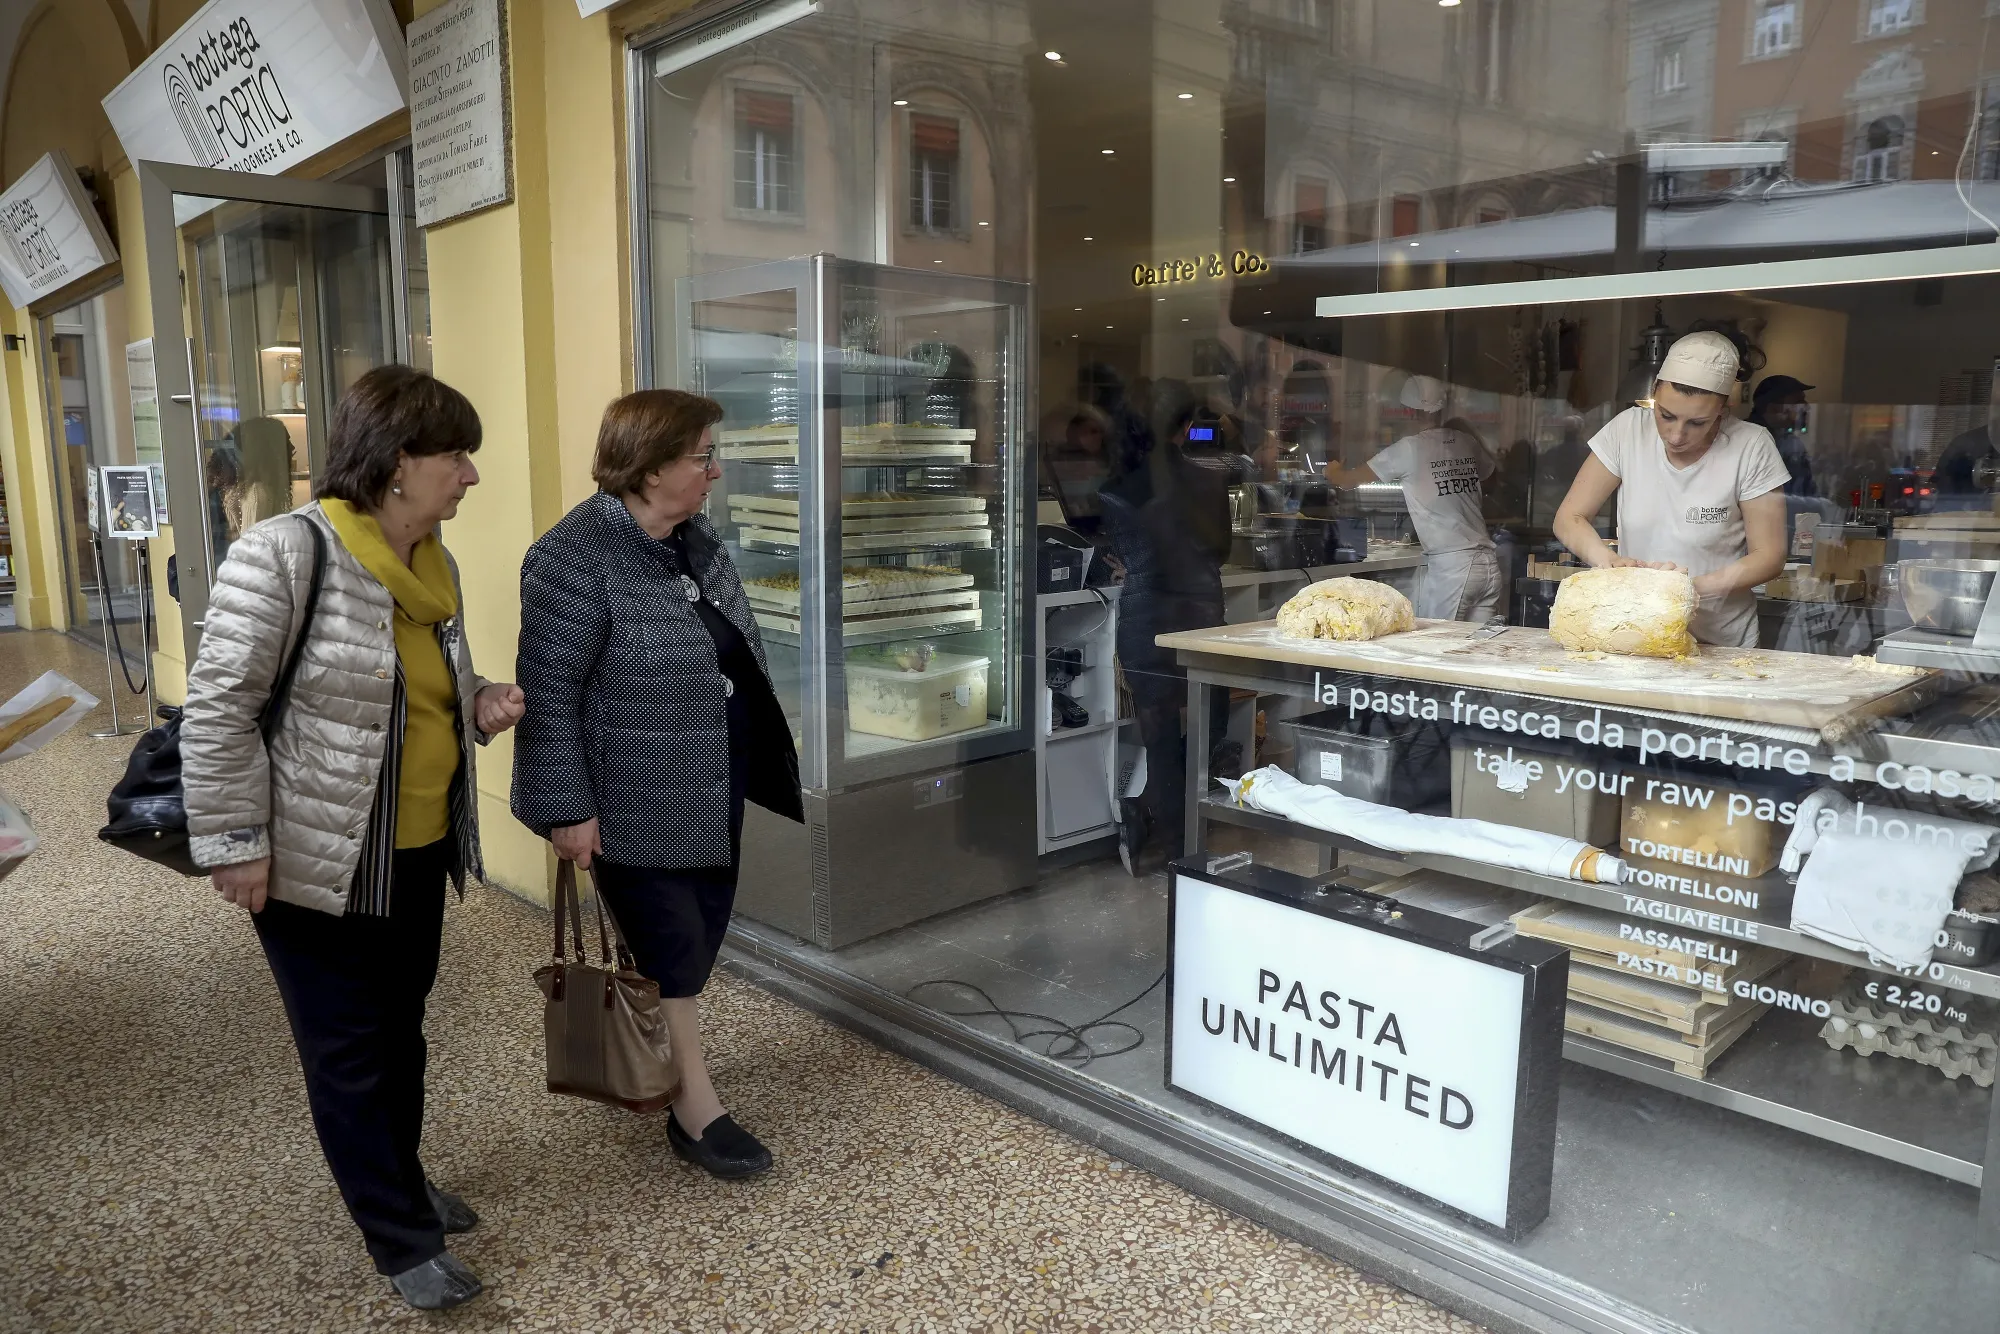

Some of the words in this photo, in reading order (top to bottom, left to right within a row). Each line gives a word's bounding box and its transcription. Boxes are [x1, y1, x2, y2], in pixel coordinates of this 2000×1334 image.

[697, 12, 758, 45] bottegaportici.it
[180, 16, 260, 92] bottega
[414, 63, 451, 94] GIACINTO
[456, 39, 494, 73] ZANOTTI
[206, 62, 292, 157] PORTICI
[276, 138, 286, 154] &
[3, 198, 38, 233] bottega
[20, 226, 62, 274] PORTICI
[1132, 256, 1202, 286] Caffe'
[1206, 254, 1224, 278] &
[1230, 250, 1268, 274] Co.
[1430, 460, 1452, 468] DON'T
[1432, 468, 1478, 479] TORTELLINI
[1435, 478, 1479, 496] HERE
[1314, 672, 1338, 706] la
[1349, 686, 1438, 721] pasta
[1450, 690, 1561, 740] fresca
[1575, 709, 1624, 749] da
[1639, 726, 1811, 776] portare
[1828, 754, 1856, 783] a
[1876, 760, 1995, 804] casa
[1474, 746, 1544, 782] take
[1556, 764, 1635, 797] your
[1646, 779, 1716, 811] raw
[1854, 802, 1989, 857] home
[1628, 838, 1750, 877] TORTELLINI
[1626, 867, 1758, 910] TORTELLONI
[1623, 895, 1758, 940] TAGLIATELLE
[1620, 924, 1738, 966] PASSATELLI
[1952, 941, 1976, 956] /hg
[1617, 952, 1679, 980] PASTA
[1686, 968, 1728, 993] DEL
[1734, 980, 1832, 1018] GIORNO
[1864, 982, 1879, 999] €
[1886, 986, 1942, 1013] 2,20
[1945, 1006, 1968, 1022] /hg
[1948, 974, 1971, 988] /hg
[1258, 968, 1408, 1056] PASTA
[1202, 996, 1474, 1130] UNLIMITED
